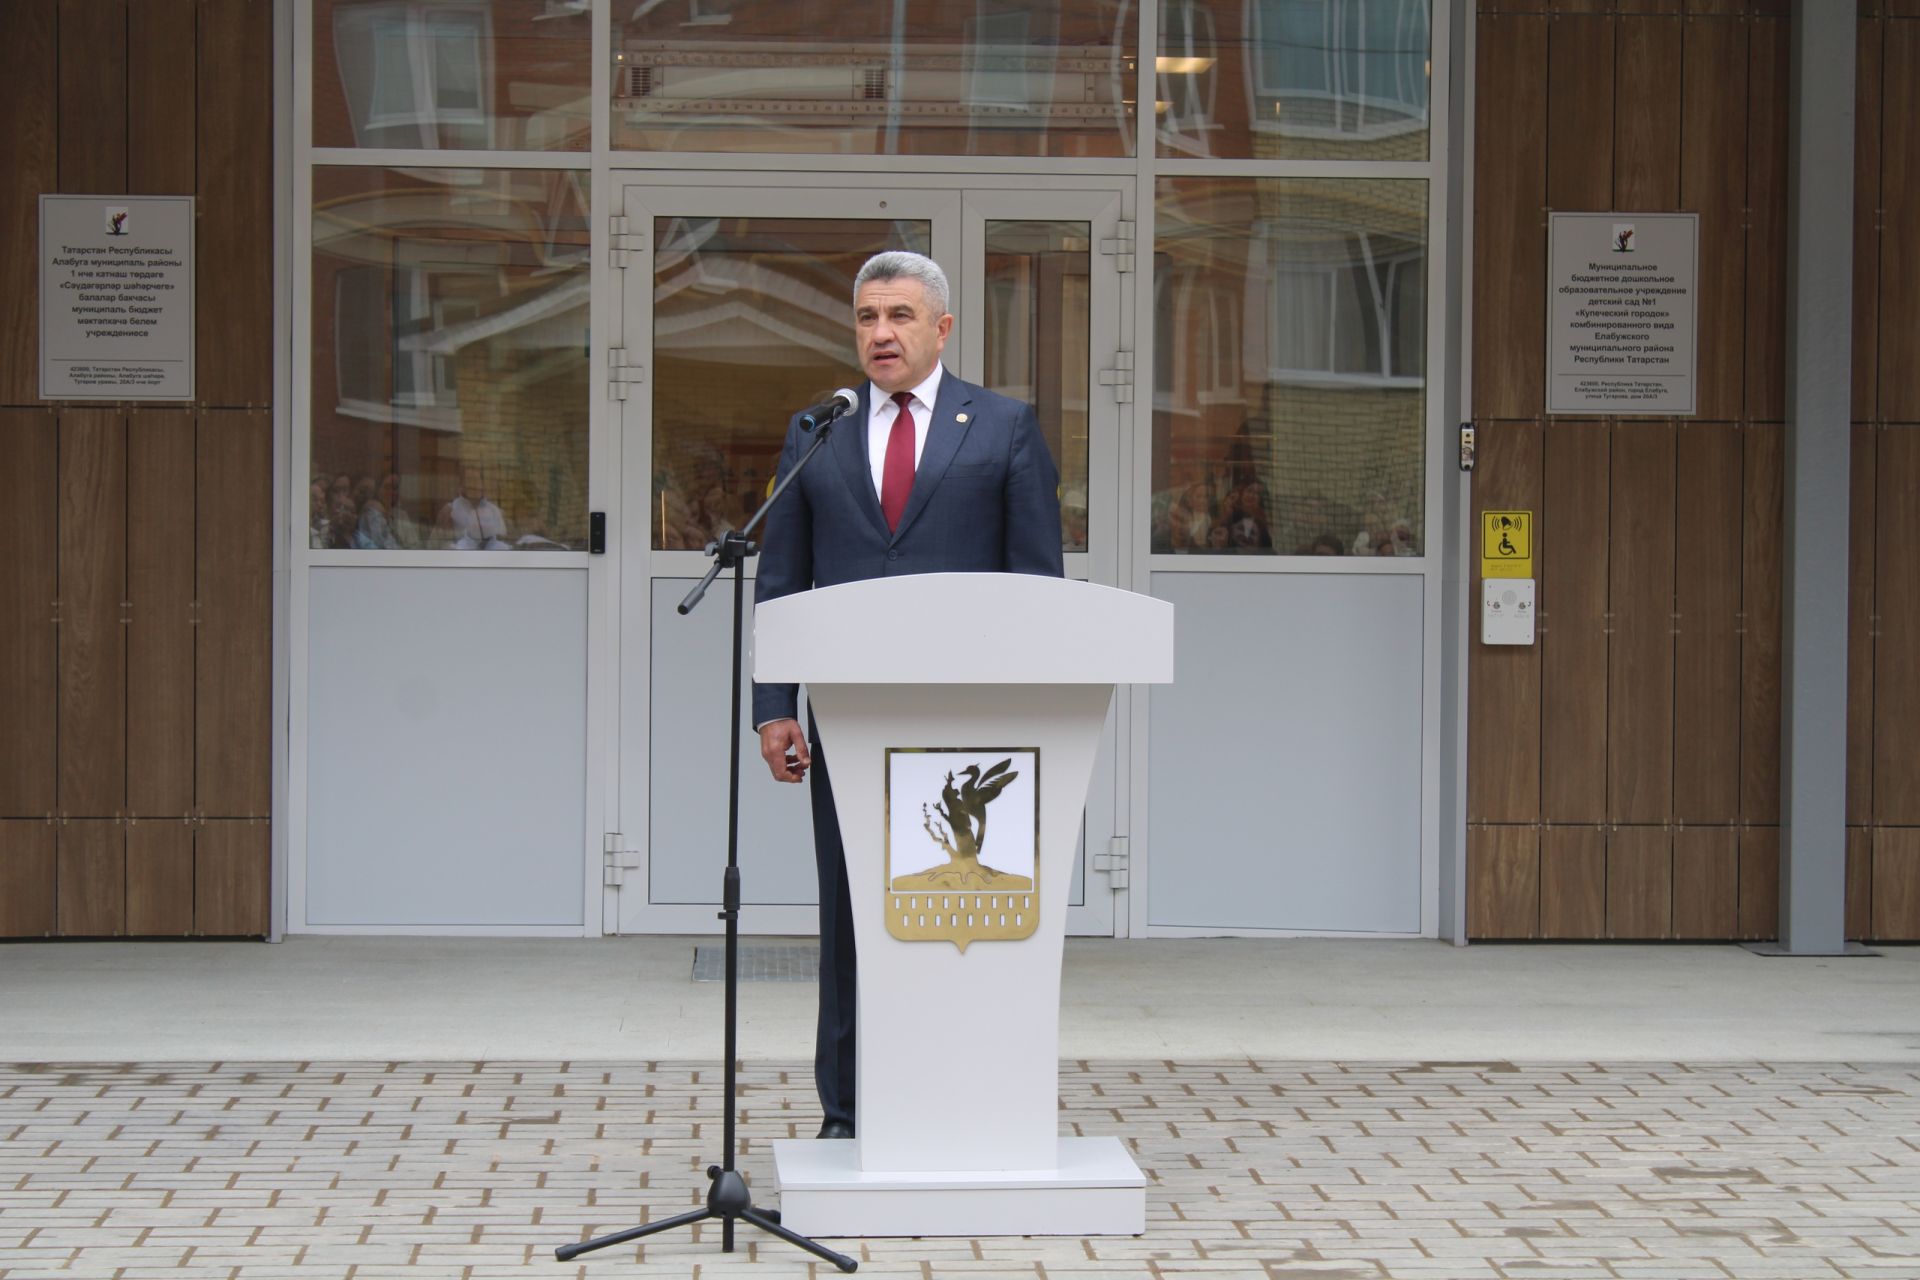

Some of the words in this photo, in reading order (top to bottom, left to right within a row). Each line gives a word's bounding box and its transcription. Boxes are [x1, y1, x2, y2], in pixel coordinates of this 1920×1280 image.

[62, 246, 106, 255] Татарстан
[109, 246, 172, 256] Республикасы
[52, 258, 88, 267] Алабуга
[91, 259, 145, 268] муниципаль
[148, 259, 182, 268] районы
[1589, 263, 1657, 271] Муниципальное
[1572, 275, 1619, 283] бюджетное
[1559, 286, 1633, 295] образовательное
[79, 294, 115, 302] балалар
[1588, 298, 1622, 306] детский
[129, 306, 163, 314] бюджет
[1576, 310, 1628, 318] «Купеческий
[1570, 321, 1651, 330] комбинированного
[1594, 333, 1649, 342] Елабужского
[1570, 345, 1641, 353] муниципального
[1644, 345, 1674, 353] района
[1574, 356, 1624, 365] Республики
[1627, 356, 1669, 365] Татарстан
